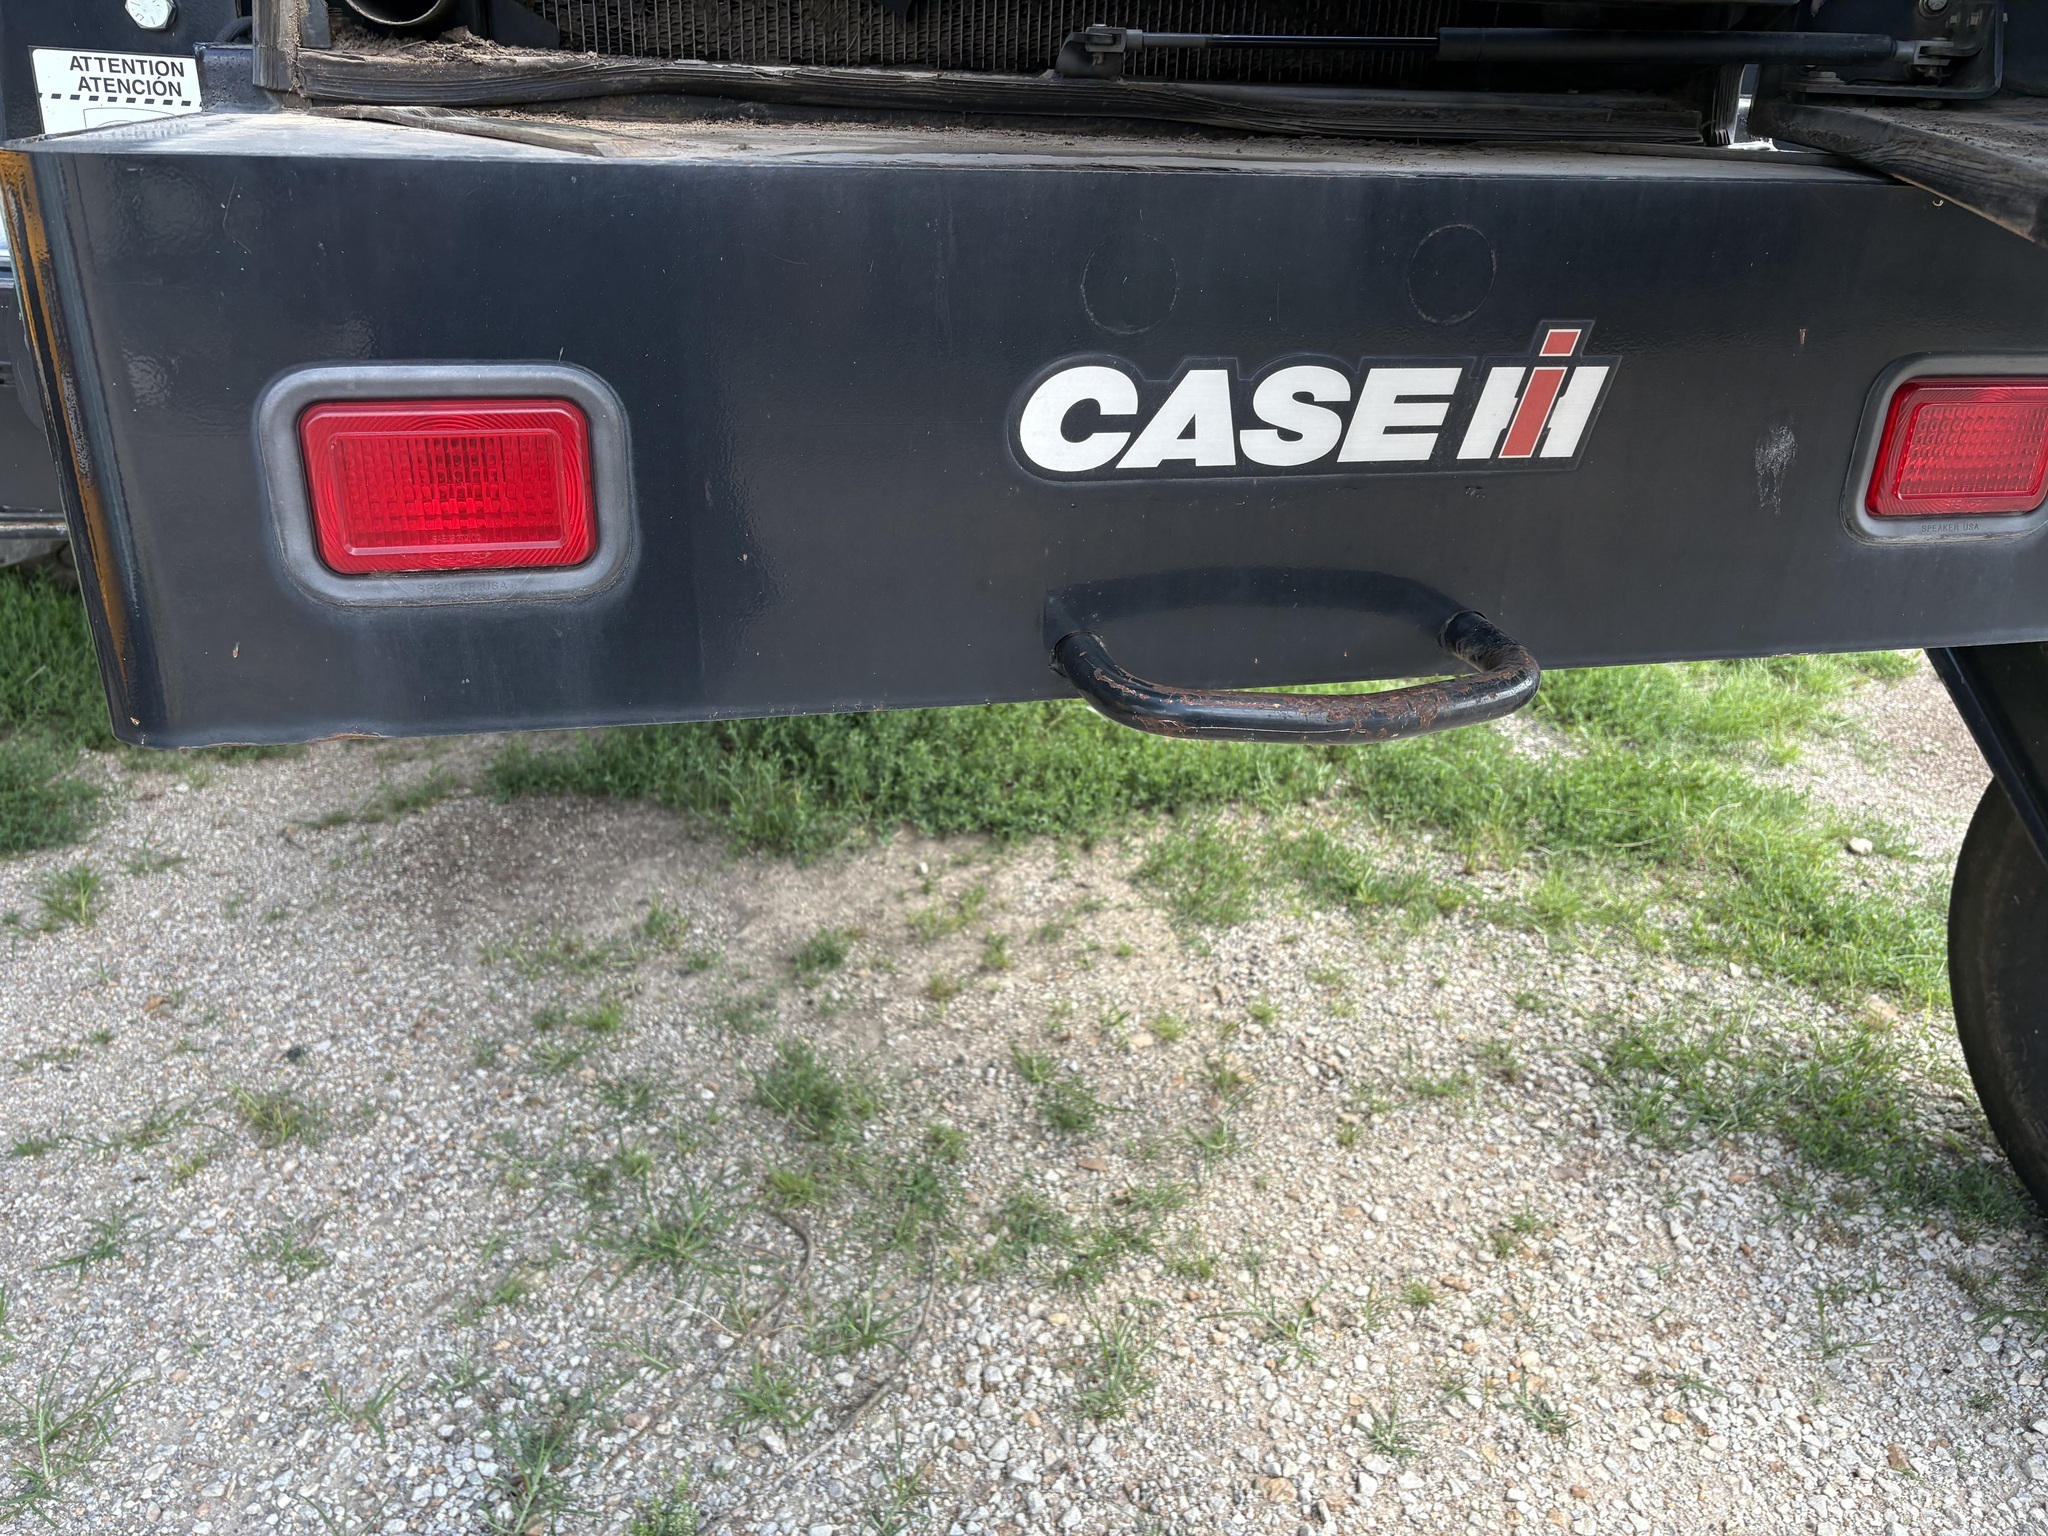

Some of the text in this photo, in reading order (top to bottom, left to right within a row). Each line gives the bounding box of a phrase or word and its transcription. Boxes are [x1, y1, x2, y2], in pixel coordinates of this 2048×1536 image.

[70, 55, 185, 77] ATTENTION
[78, 76, 182, 97] ATENCIÓN
[1019, 365, 1462, 472] CASE
[1921, 523, 1979, 533] SPEAKER USA
[417, 581, 508, 594] SPEAKER USA
